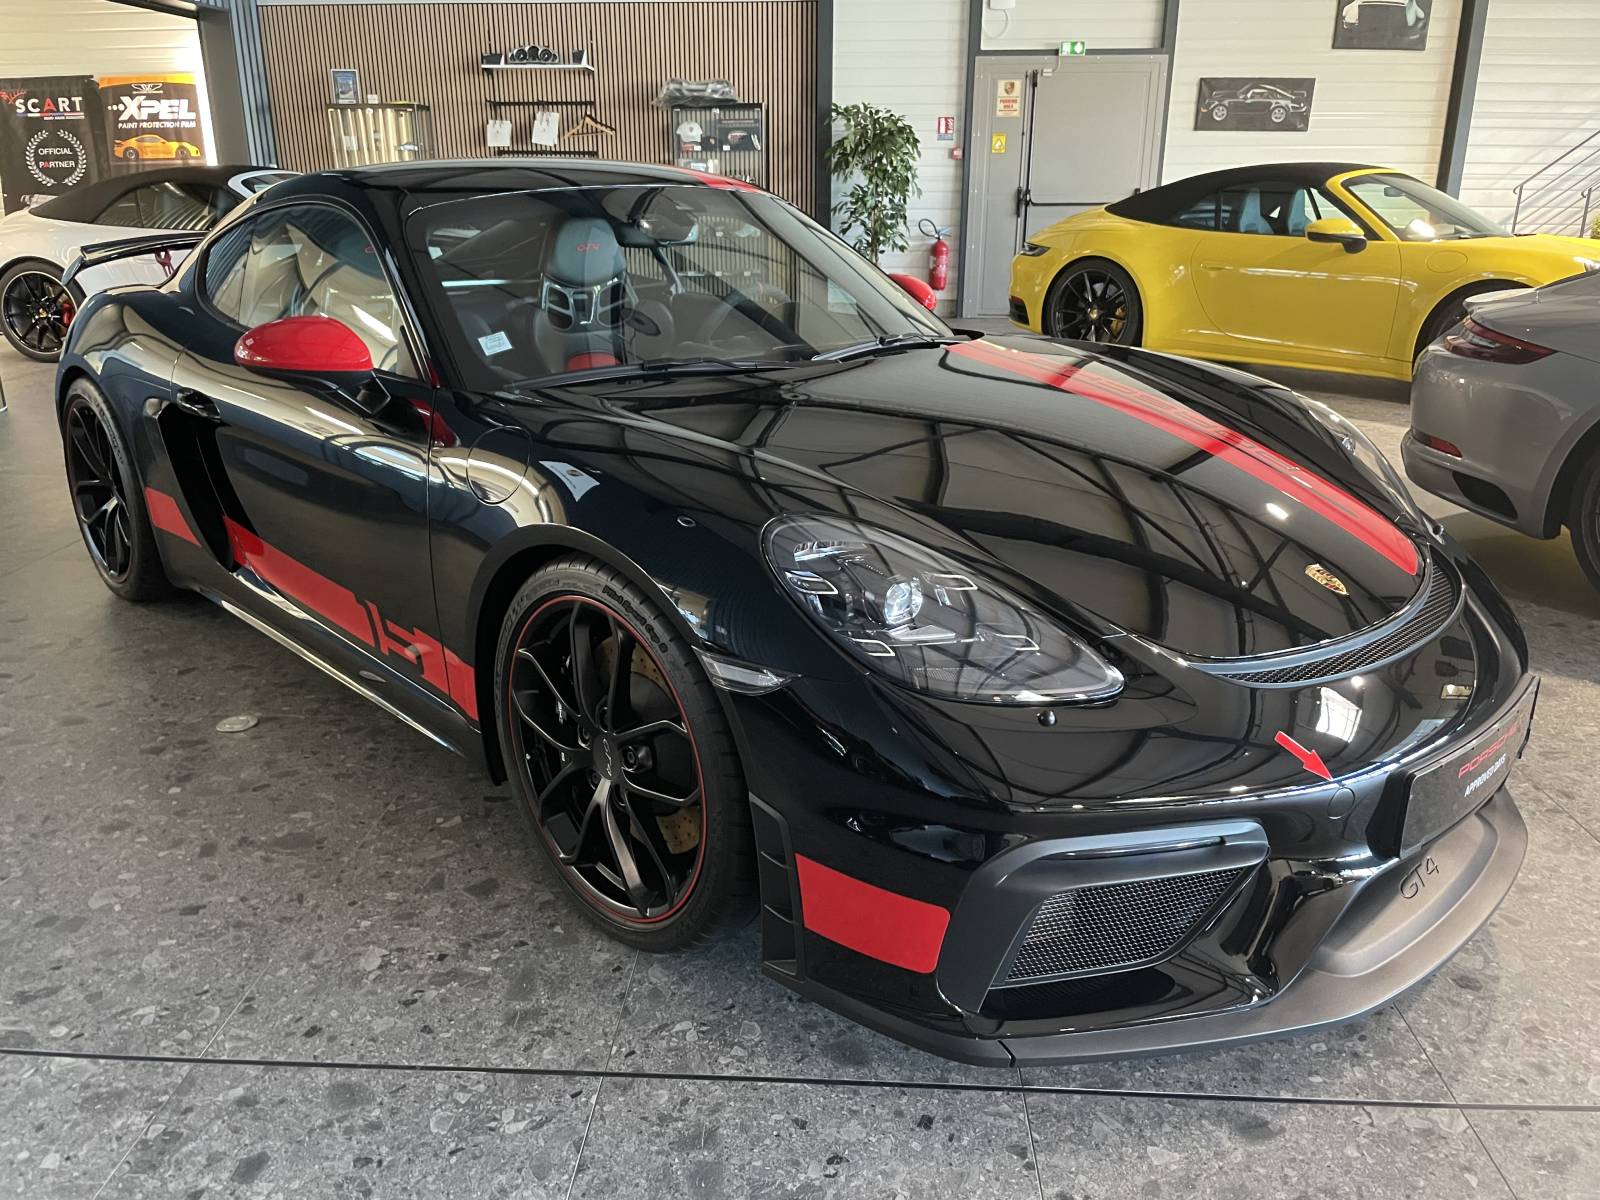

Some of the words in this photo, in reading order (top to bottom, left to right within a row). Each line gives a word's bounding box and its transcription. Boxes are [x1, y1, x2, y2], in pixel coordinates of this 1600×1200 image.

[16, 96, 84, 113] SCART
[118, 95, 197, 121] XPEL
[118, 121, 138, 129] PAINT
[139, 121, 180, 129] PROTECTION
[38, 147, 73, 156] OFFICIAL
[39, 160, 76, 169] PARTNER
[1399, 856, 1441, 900] GT4
